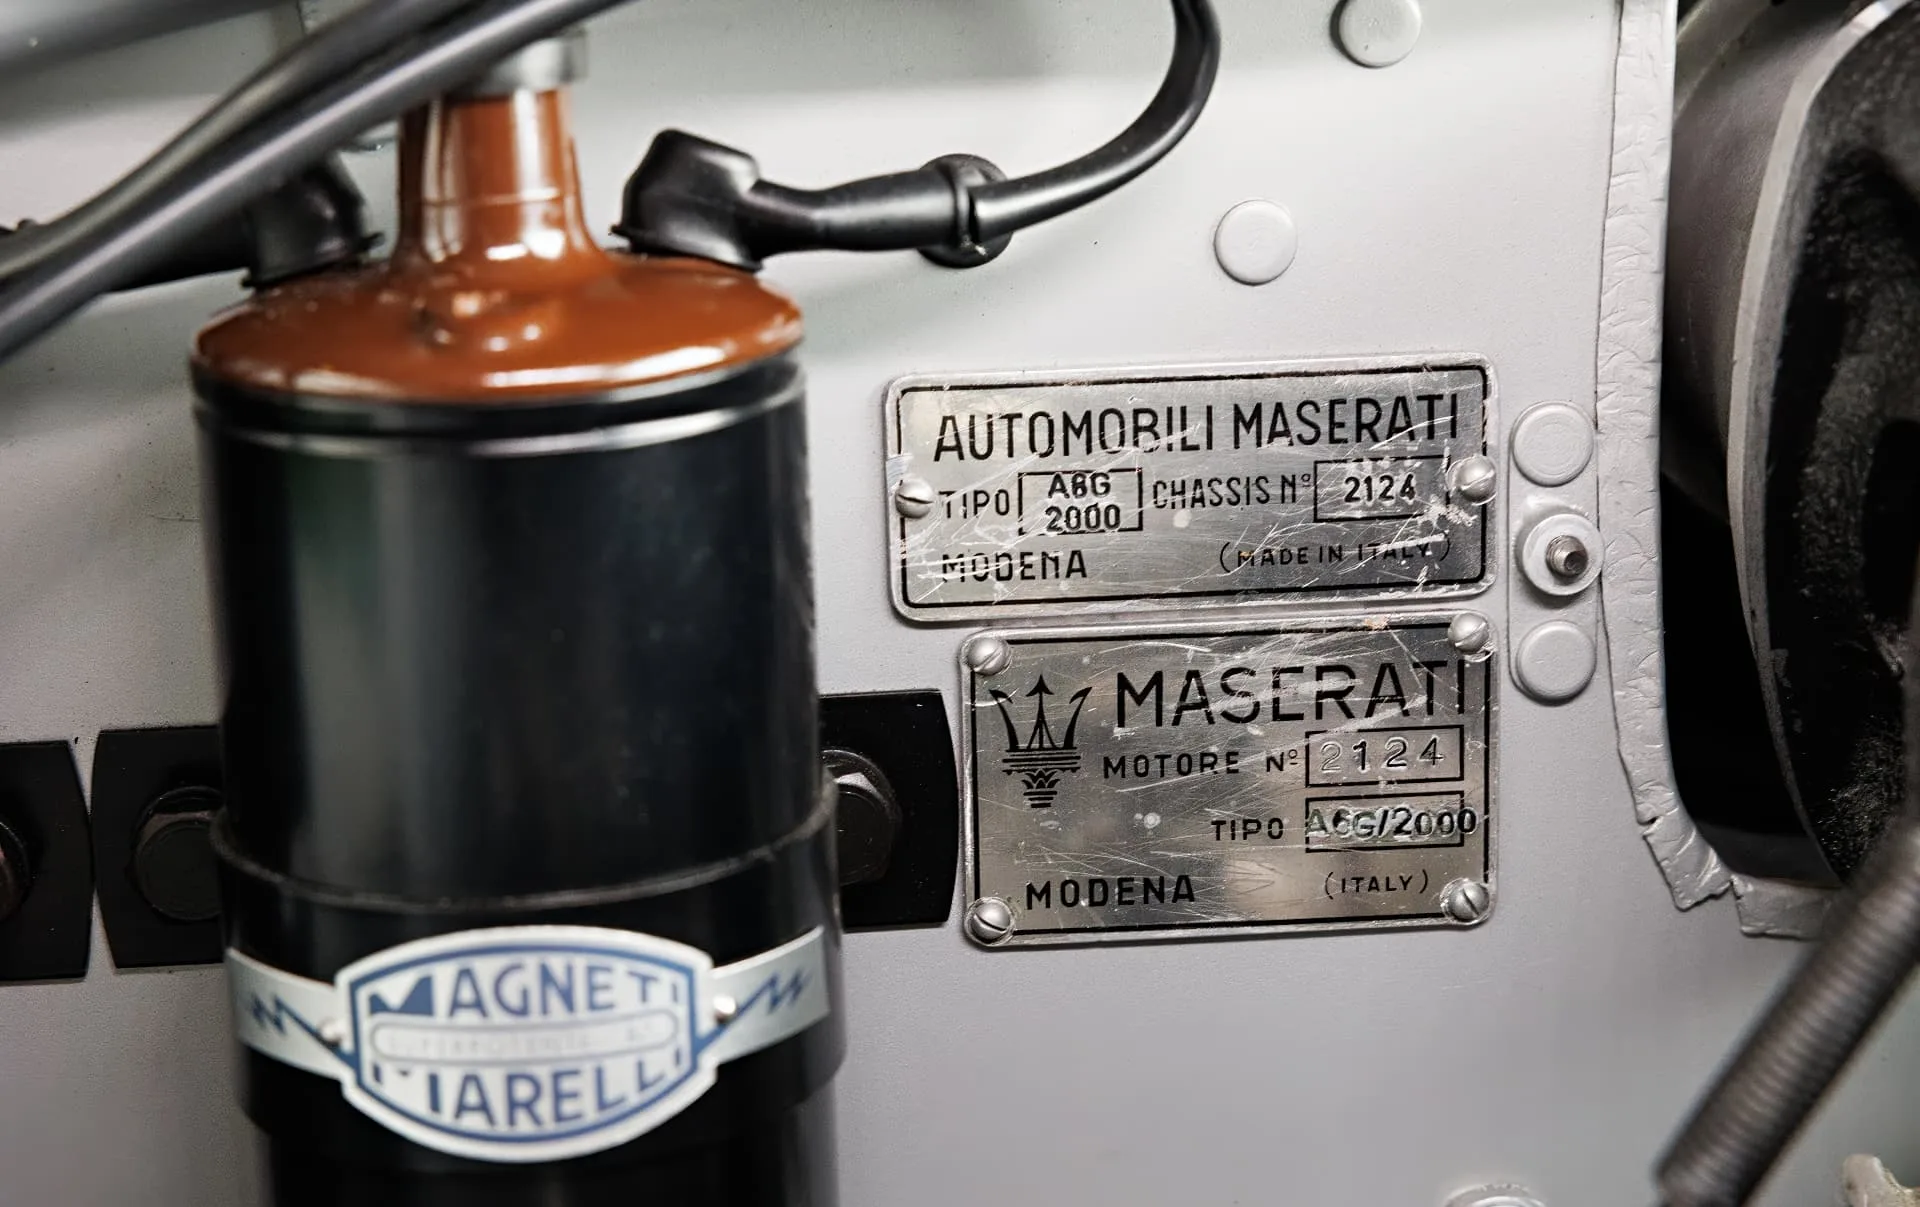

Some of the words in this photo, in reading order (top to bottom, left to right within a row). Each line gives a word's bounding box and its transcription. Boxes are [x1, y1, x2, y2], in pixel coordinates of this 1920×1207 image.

[933, 404, 1214, 462] AUTOMOBILI
[1233, 393, 1458, 449] MASERATI
[939, 489, 1010, 519] TIPO
[1152, 475, 1271, 510] CHASSIS
[1344, 473, 1416, 504] 2124
[1045, 503, 1121, 532] 2000
[942, 549, 1088, 584] MODENA
[1319, 545, 1343, 562] IN
[1116, 658, 1466, 729] MASERATI
[1102, 752, 1240, 779] MOTORE
[1320, 735, 1445, 773] 2124
[1211, 817, 1285, 842] TIPO
[1306, 804, 1478, 839] A6G/2000
[1026, 874, 1196, 911] MODENA
[1324, 868, 1429, 899] (ITALY)
